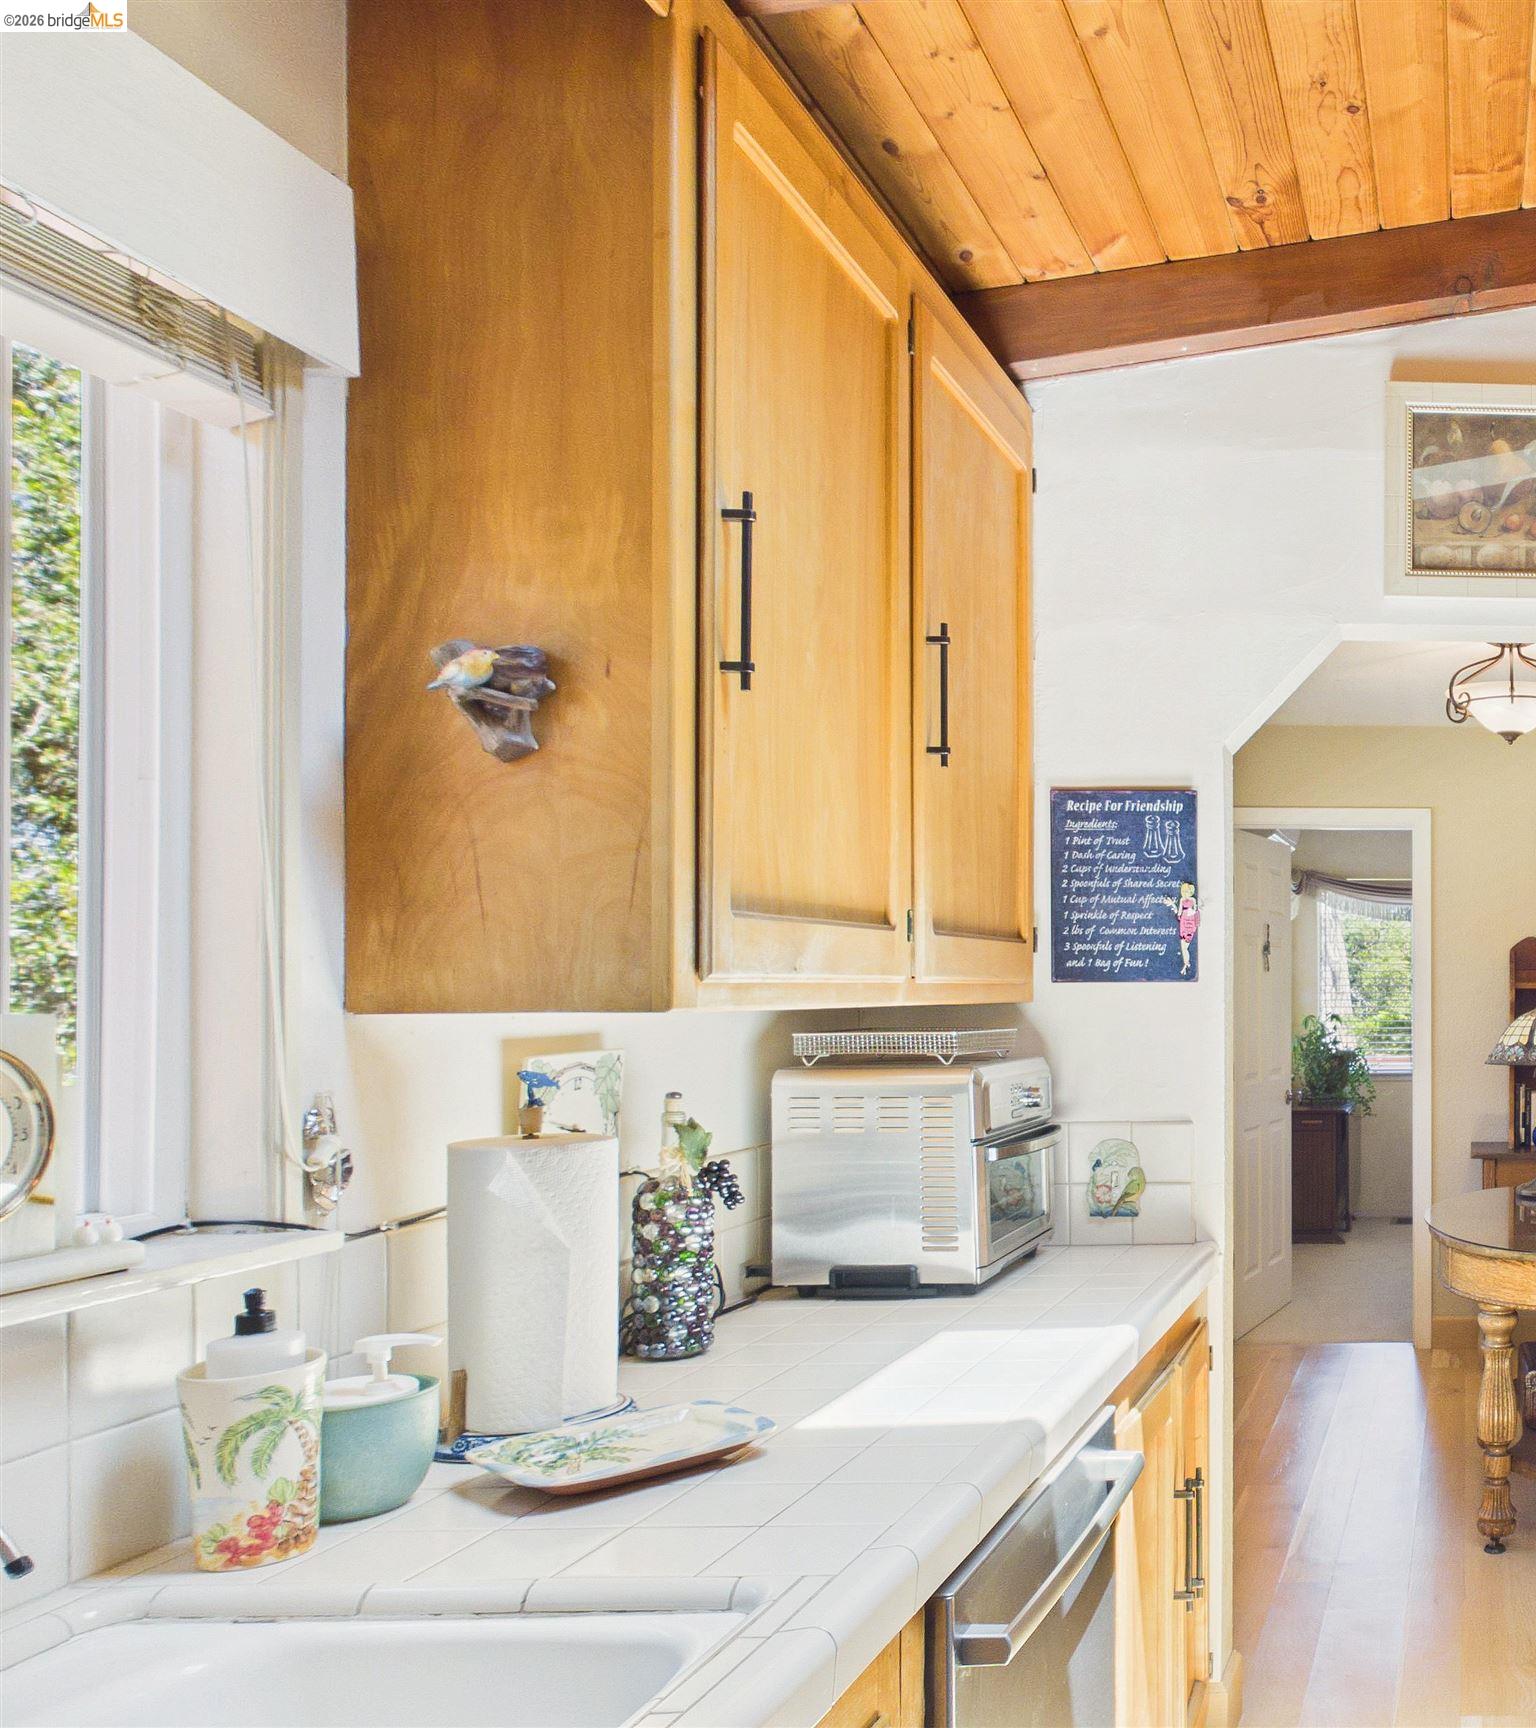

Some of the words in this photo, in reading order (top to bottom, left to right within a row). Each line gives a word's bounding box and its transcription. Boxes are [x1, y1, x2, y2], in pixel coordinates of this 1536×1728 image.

[1066, 801, 1101, 813] Recipe
[1105, 800, 1123, 811] For
[1125, 800, 1184, 814] Friendship
[1065, 819, 1118, 832] Ingredients:
[1065, 837, 1070, 845] 1
[1072, 836, 1090, 845] Pint
[1093, 835, 1104, 850] of
[1106, 837, 1130, 845] Trust
[1064, 850, 1069, 859] 1
[1072, 850, 1093, 859] Dash
[1095, 850, 1106, 865] of
[1106, 851, 1136, 864] Caring
[1062, 865, 1068, 873] 2
[1071, 865, 1091, 877] Cups
[1093, 865, 1103, 880] of
[1062, 880, 1068, 888] 2
[1070, 880, 1109, 891] Spoonfuls
[1112, 879, 1121, 893] of
[1123, 880, 1154, 888] Shared
[1063, 896, 1068, 904] 1
[1070, 895, 1087, 907] Cup
[1089, 894, 1099, 909] of
[1100, 894, 1137, 904] Mutual
[1064, 911, 1068, 919] 1
[1070, 911, 1107, 923] Sprinkle
[1109, 911, 1119, 925] of
[1121, 912, 1154, 923] Respect
[1063, 927, 1069, 935] 2
[1071, 925, 1083, 935] lbs
[1085, 925, 1096, 940] of
[1100, 927, 1138, 935] Common
[1140, 927, 1177, 935] Interests
[1064, 942, 1070, 951] 3
[1072, 942, 1112, 954] Spoonfuls
[1113, 941, 1124, 956] of
[1126, 942, 1167, 955] Listening
[1067, 958, 1085, 967] and
[1088, 959, 1092, 967] 1
[1095, 959, 1111, 972] Bag
[1113, 958, 1123, 973] of
